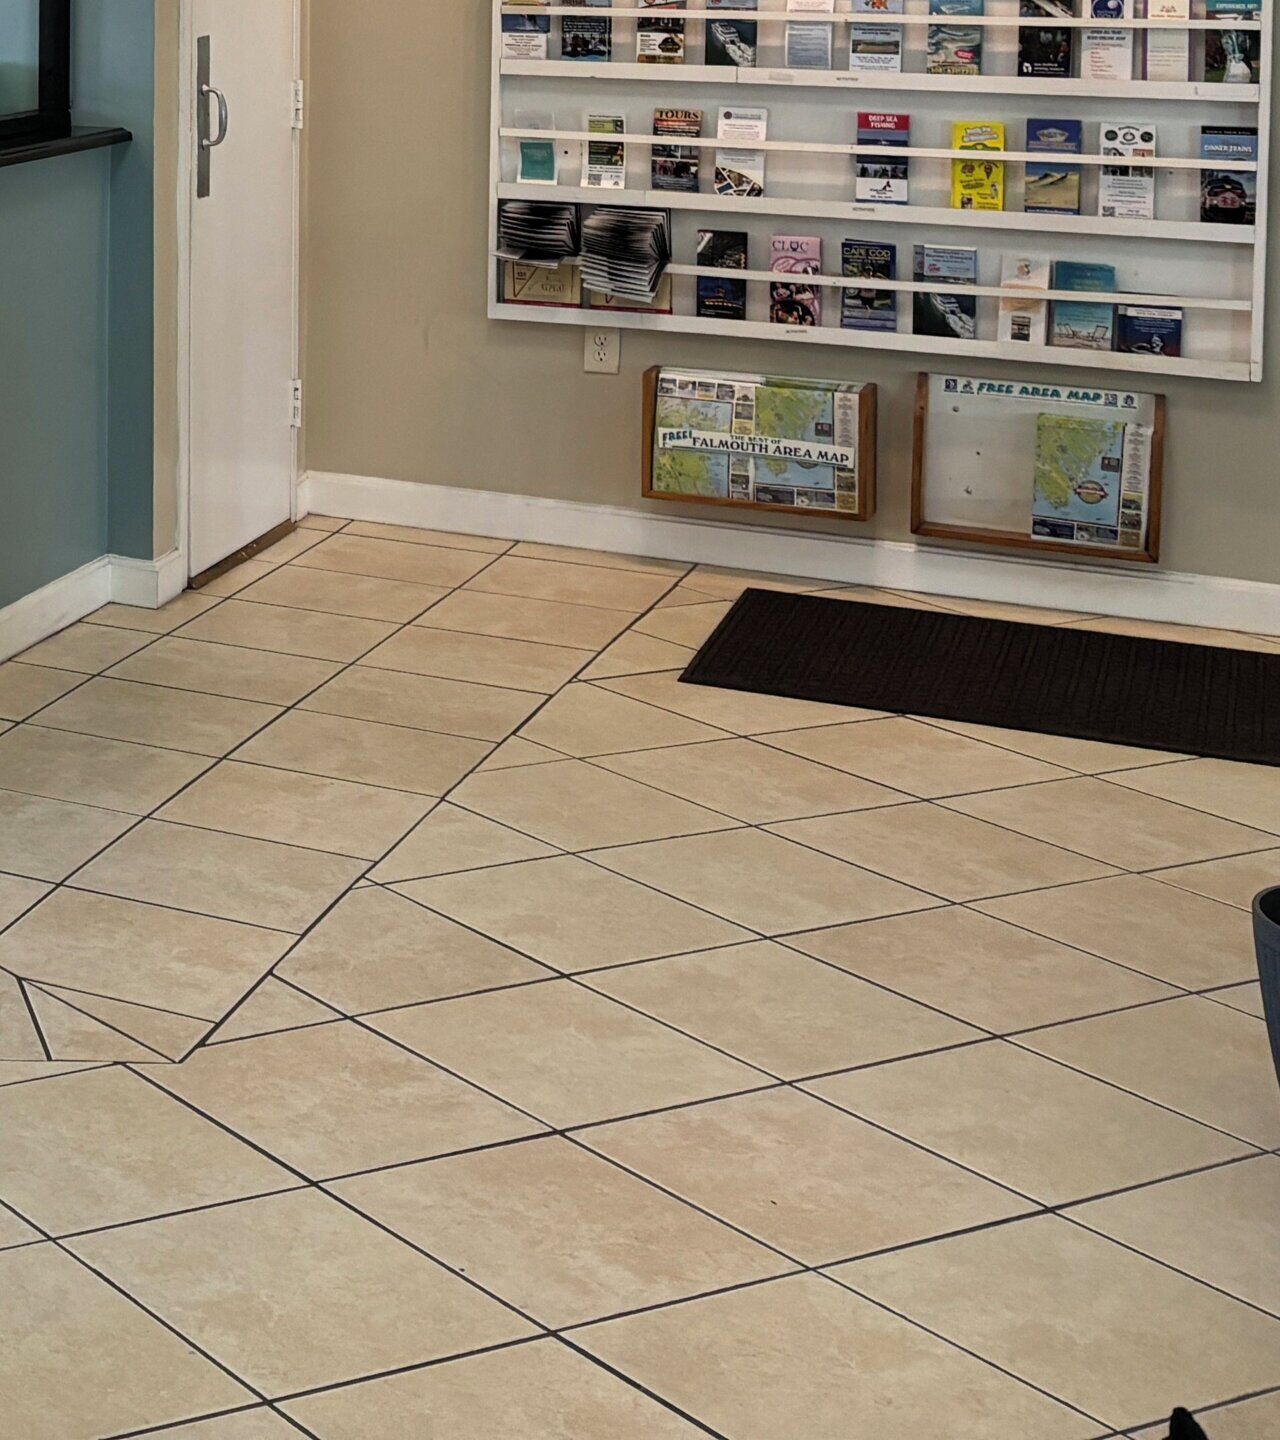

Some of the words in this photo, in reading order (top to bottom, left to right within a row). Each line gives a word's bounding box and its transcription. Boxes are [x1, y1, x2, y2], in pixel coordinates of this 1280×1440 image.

[658, 110, 700, 120] TOURS
[977, 382, 1014, 395] FREE
[1018, 386, 1062, 399] AREA
[1067, 390, 1102, 403] MAP
[662, 430, 693, 442] FREE!
[692, 437, 769, 454] FALMOUTH
[773, 445, 813, 459] AREA
[816, 451, 849, 464] MAP
